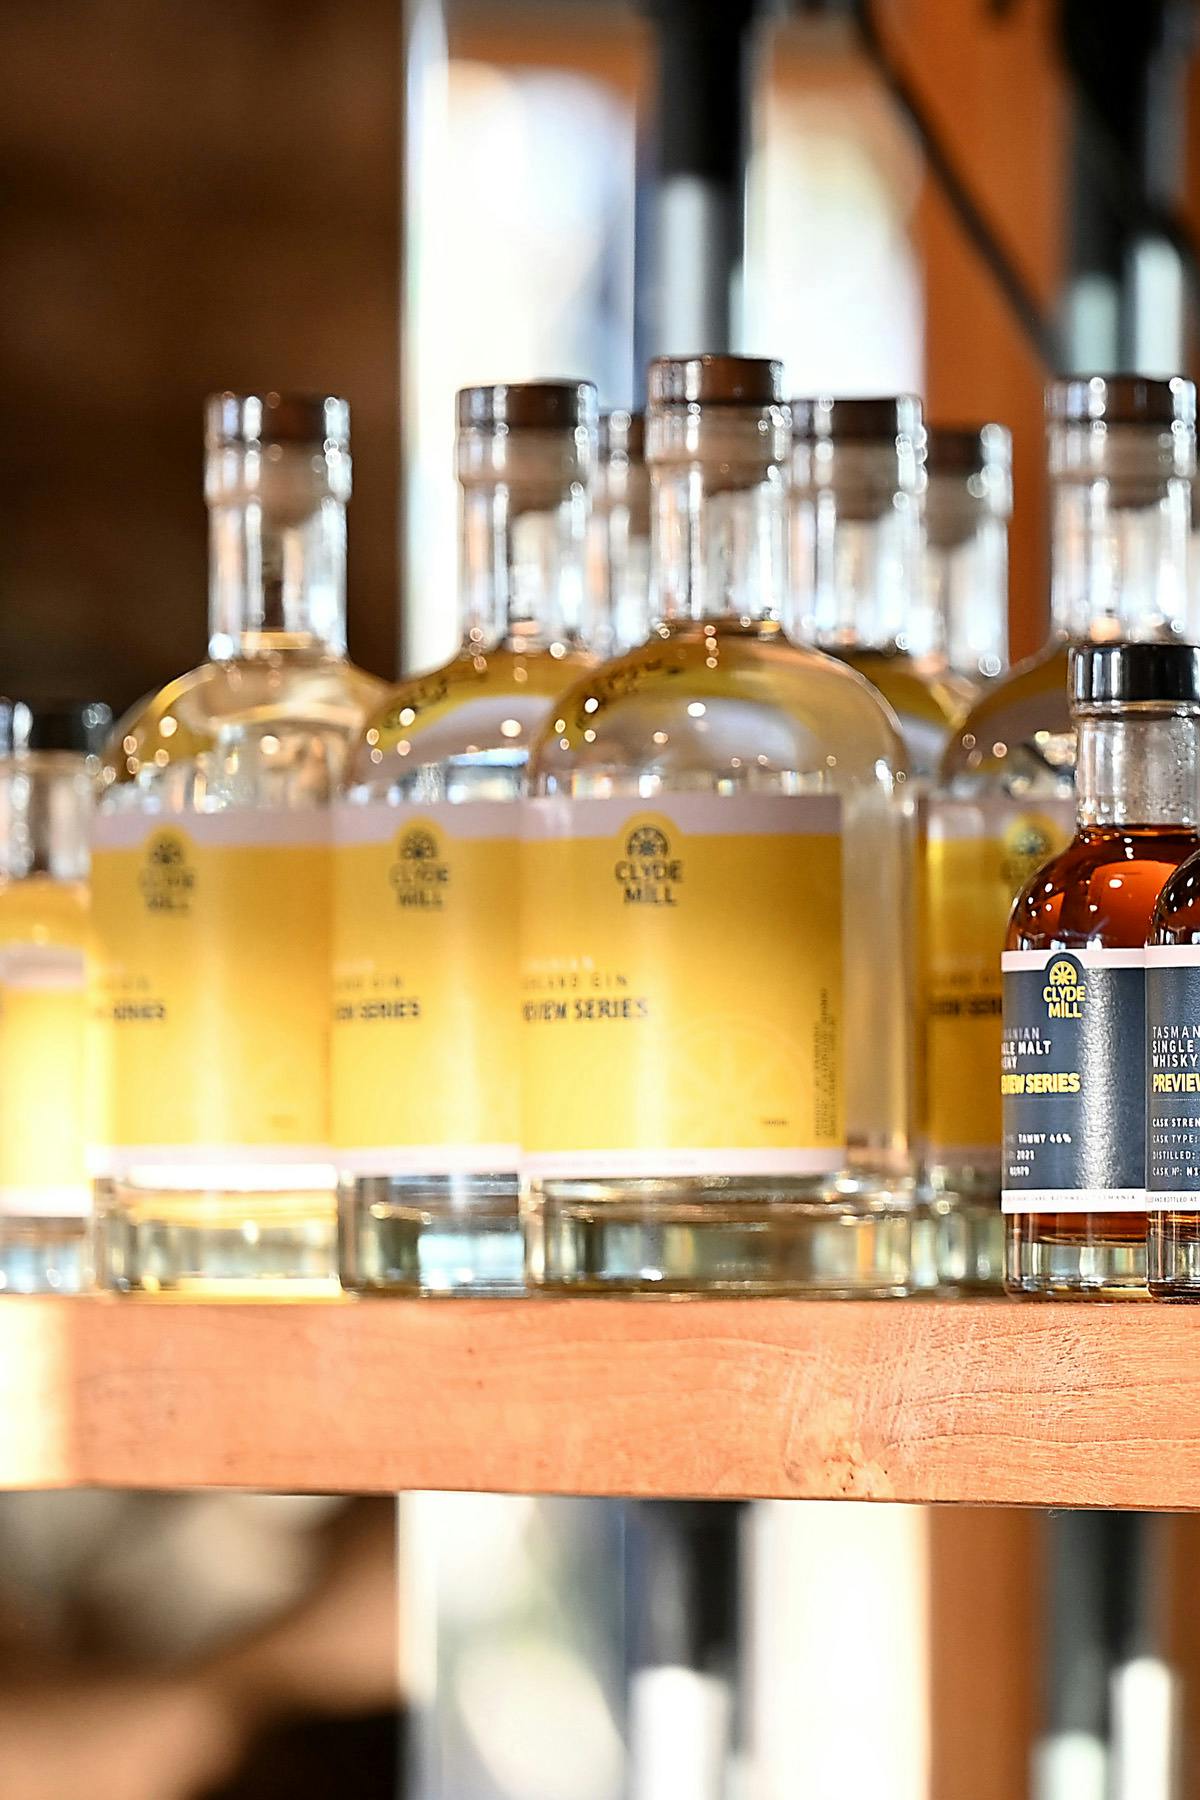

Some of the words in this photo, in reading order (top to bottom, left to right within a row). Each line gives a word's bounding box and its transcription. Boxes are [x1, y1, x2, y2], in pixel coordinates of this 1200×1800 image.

[615, 861, 683, 882] CLYDE
[624, 882, 677, 906] MILL
[1043, 985, 1086, 1003] CLYDE
[574, 998, 649, 1022] SERIES
[1048, 1000, 1083, 1019] MILL
[1018, 1041, 1052, 1055] MALT
[1152, 1039, 1195, 1054] SINGLE
[1152, 1053, 1198, 1068] WHISKY
[1026, 1073, 1081, 1094] SERIES
[1152, 1117, 1169, 1128] CASK
[1152, 1134, 1169, 1144] CASK
[1172, 1134, 1198, 1144] TYPE:
[1152, 1150, 1196, 1160] DISTILLED:
[1152, 1166, 1169, 1177] CASK
